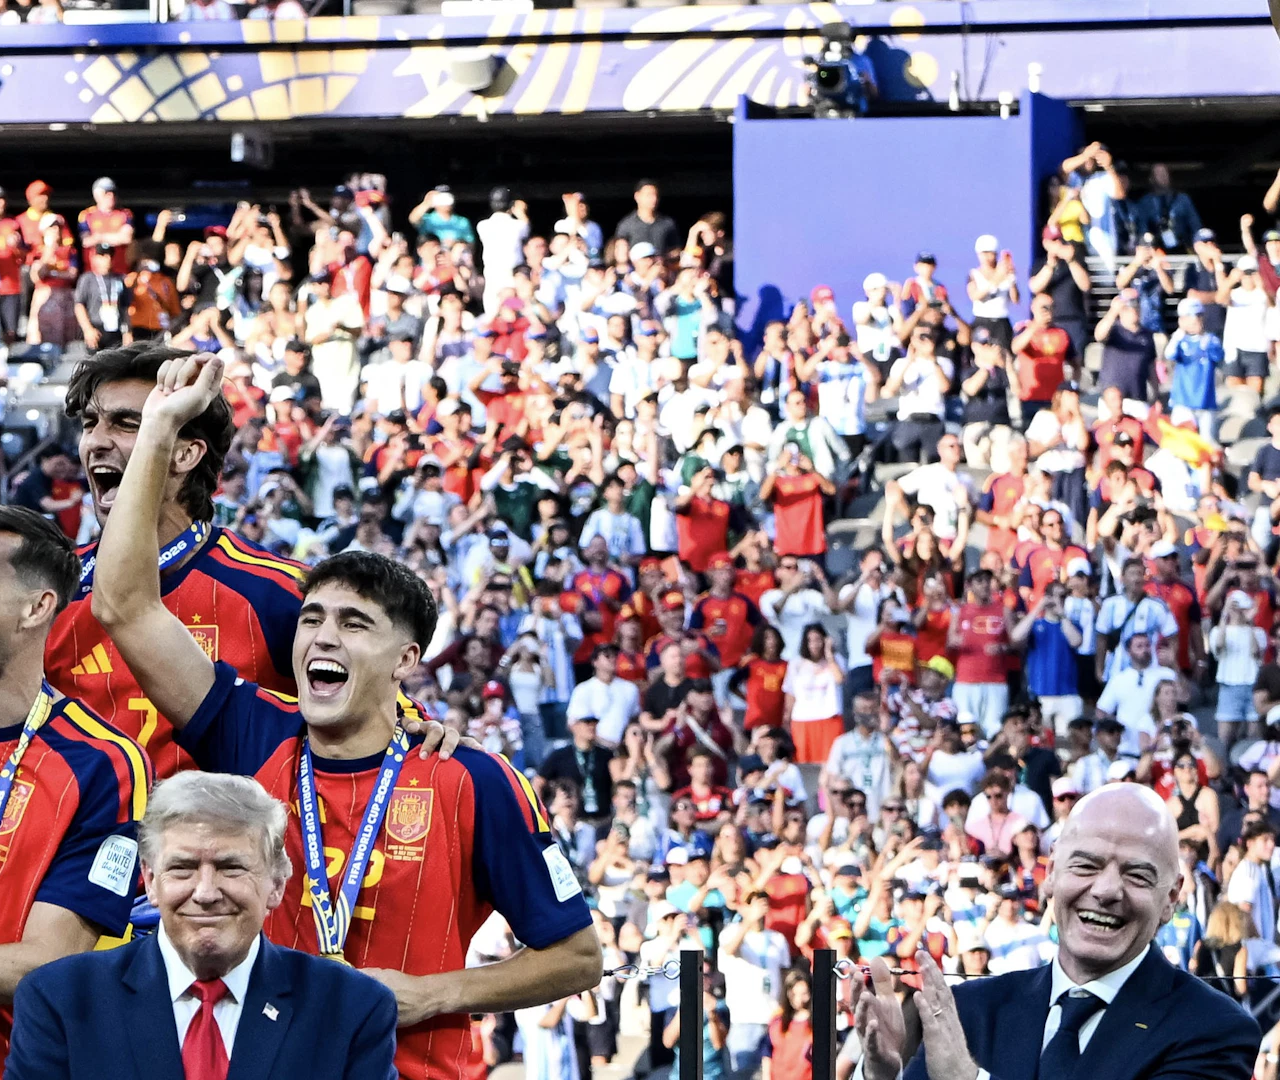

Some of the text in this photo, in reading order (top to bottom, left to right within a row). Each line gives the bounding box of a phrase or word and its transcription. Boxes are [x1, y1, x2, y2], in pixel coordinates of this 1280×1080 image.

[158, 540, 188, 567] 2026
[128, 697, 158, 748] 7
[300, 754, 321, 870] FIFA WORLD CUP 2026
[347, 768, 394, 885] FIFA WORLD CUP 2026
